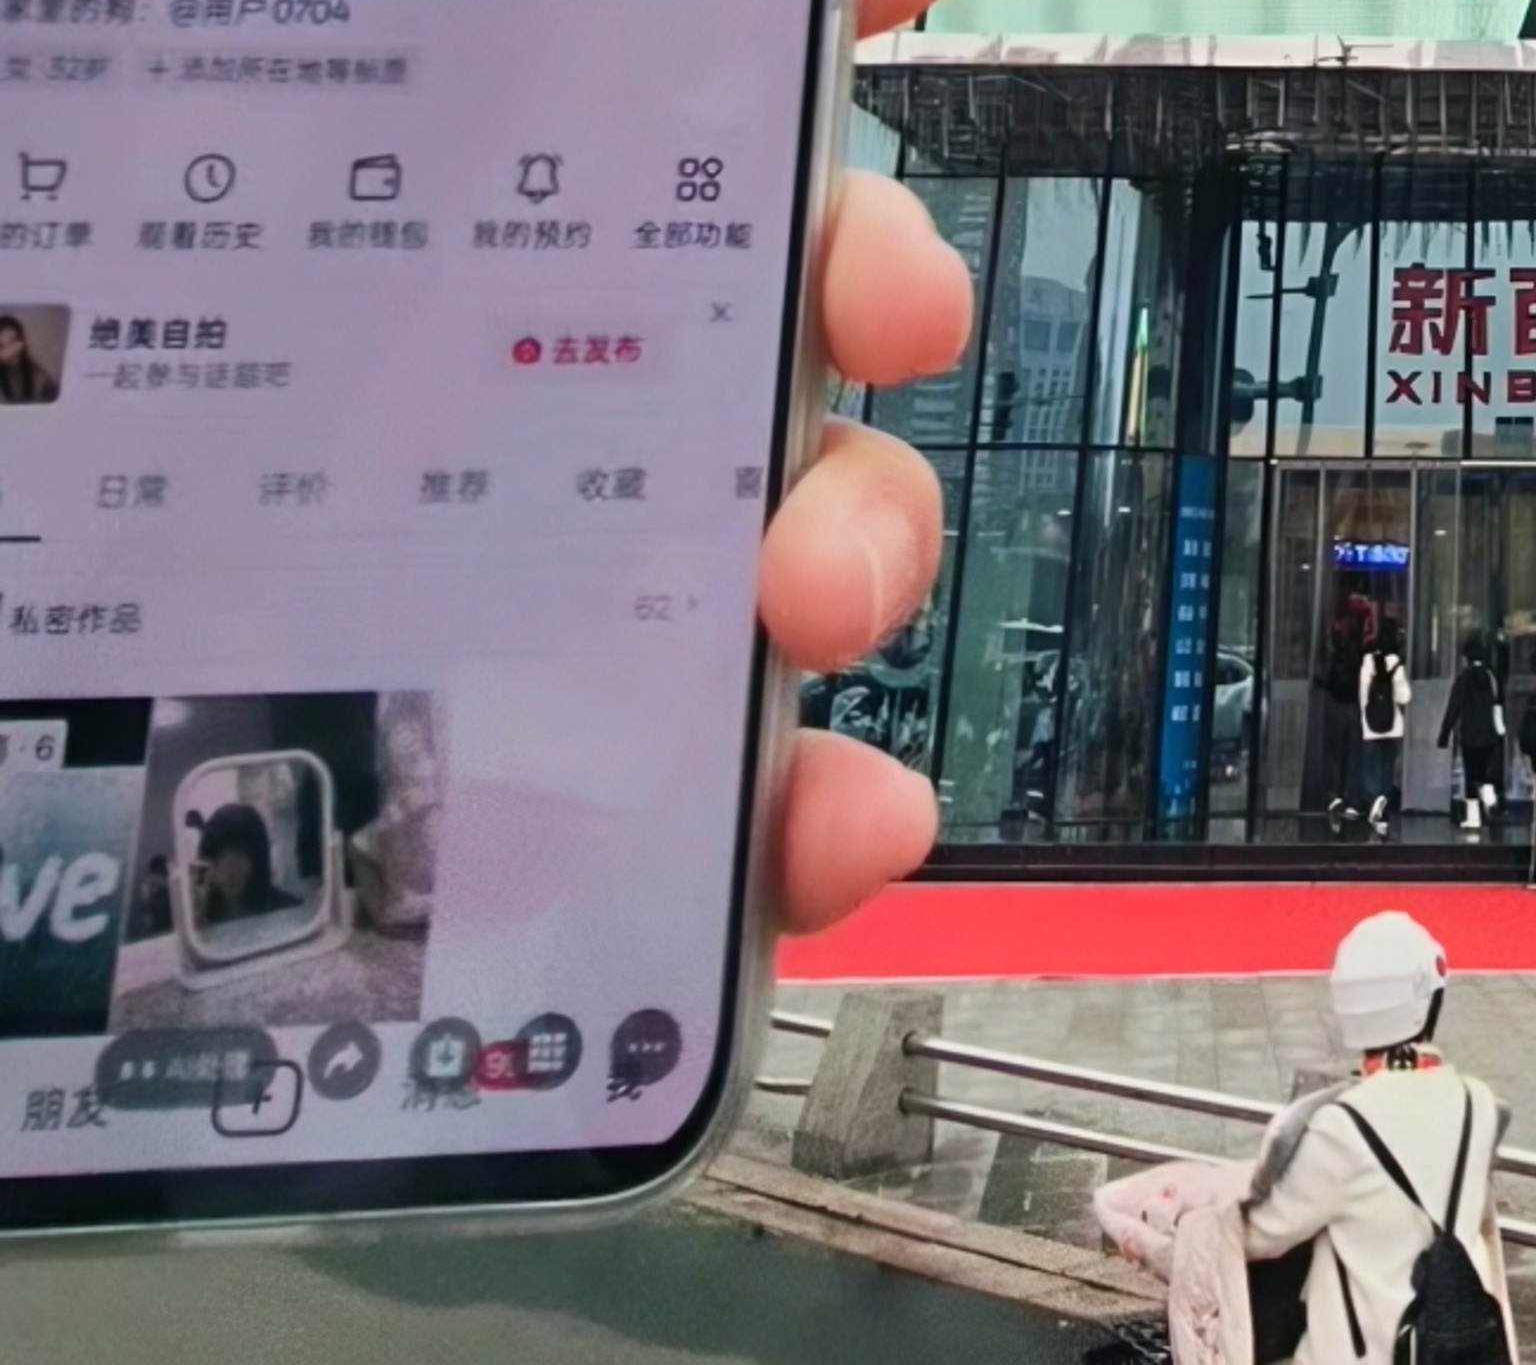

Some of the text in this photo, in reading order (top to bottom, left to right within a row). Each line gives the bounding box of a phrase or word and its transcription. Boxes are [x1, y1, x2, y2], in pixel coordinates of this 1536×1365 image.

[631, 221, 753, 250] 全部功能
[89, 316, 228, 350] 绝美自拍
[553, 335, 645, 365] 去发布
[419, 470, 491, 504] 推荐
[575, 468, 648, 501] 收藏
[10, 602, 142, 635] 私密作品
